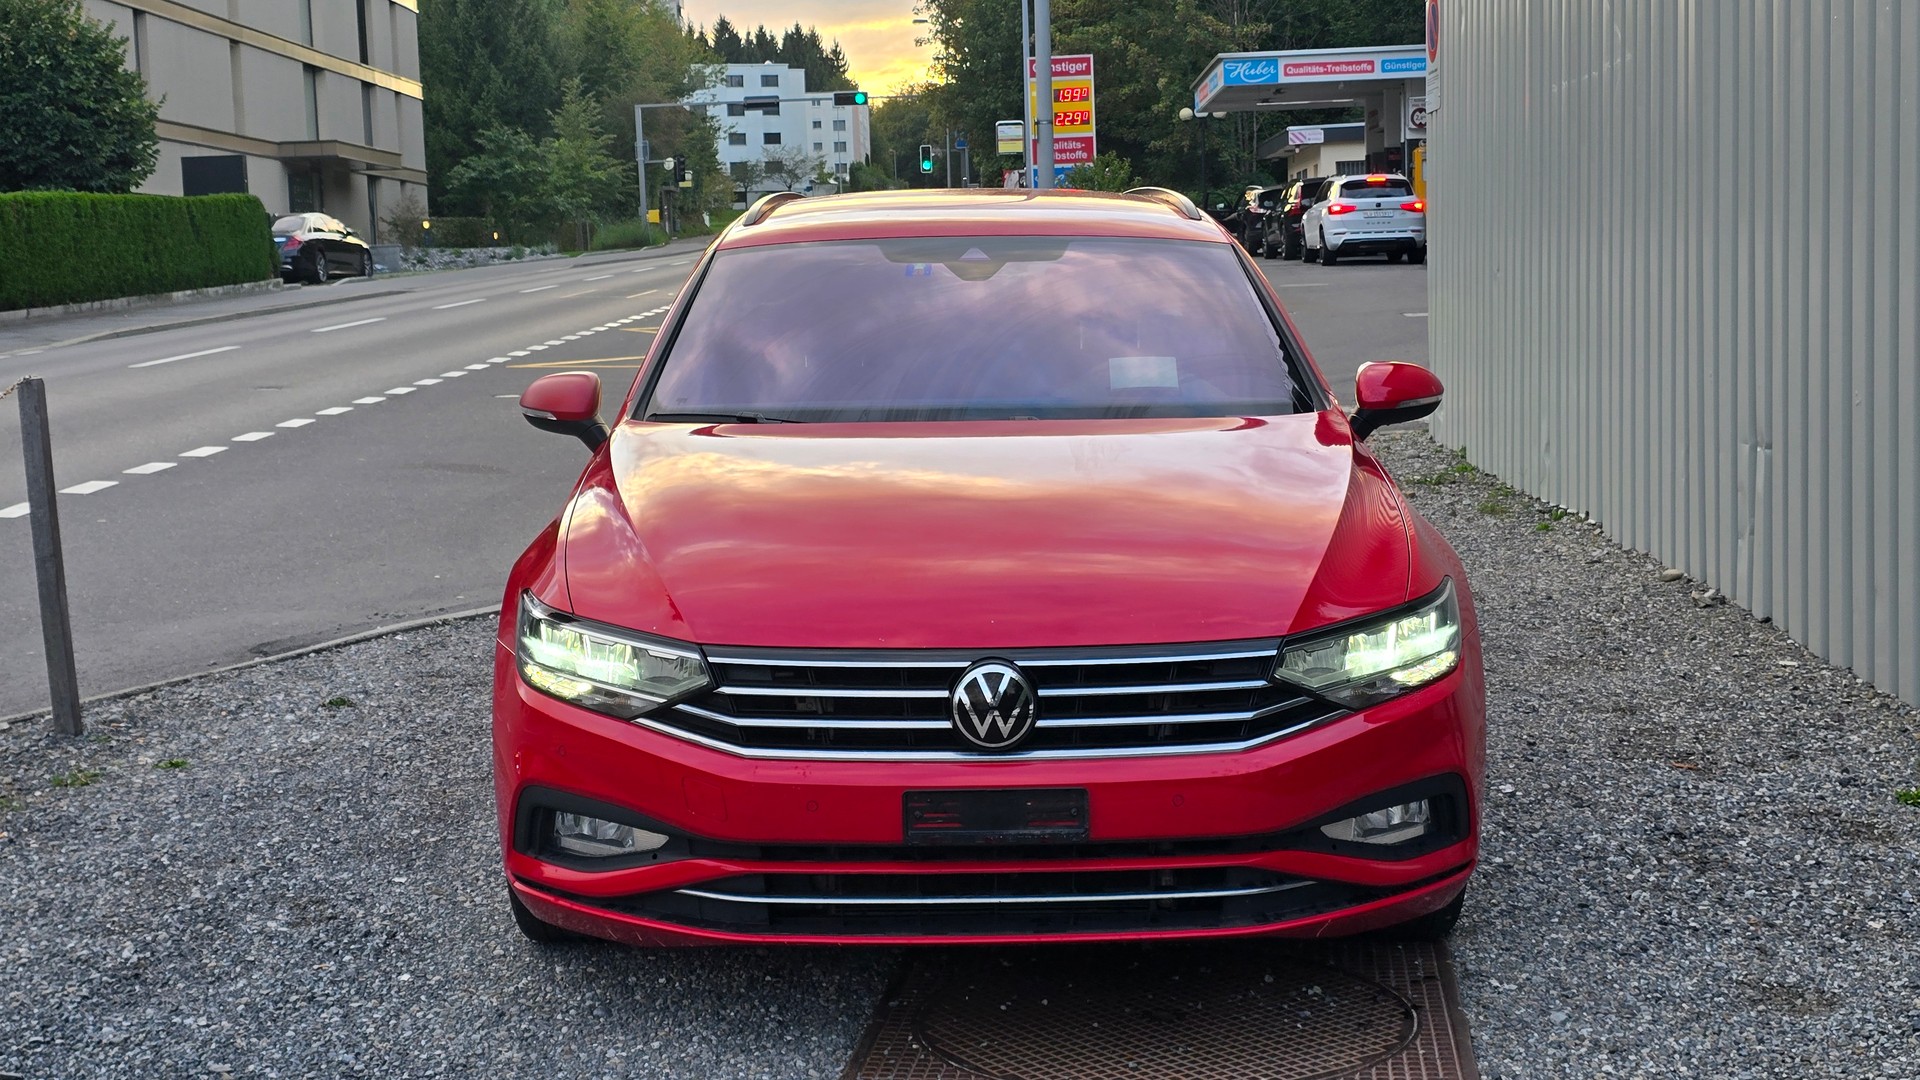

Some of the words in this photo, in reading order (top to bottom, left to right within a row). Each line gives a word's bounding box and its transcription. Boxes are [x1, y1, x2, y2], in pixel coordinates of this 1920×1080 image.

[1286, 63, 1372, 75] Qualitäts-Treibstoffe
[1384, 61, 1426, 71] Günstiger
[1225, 61, 1276, 83] Huber
[1053, 140, 1086, 150] alitäts-
